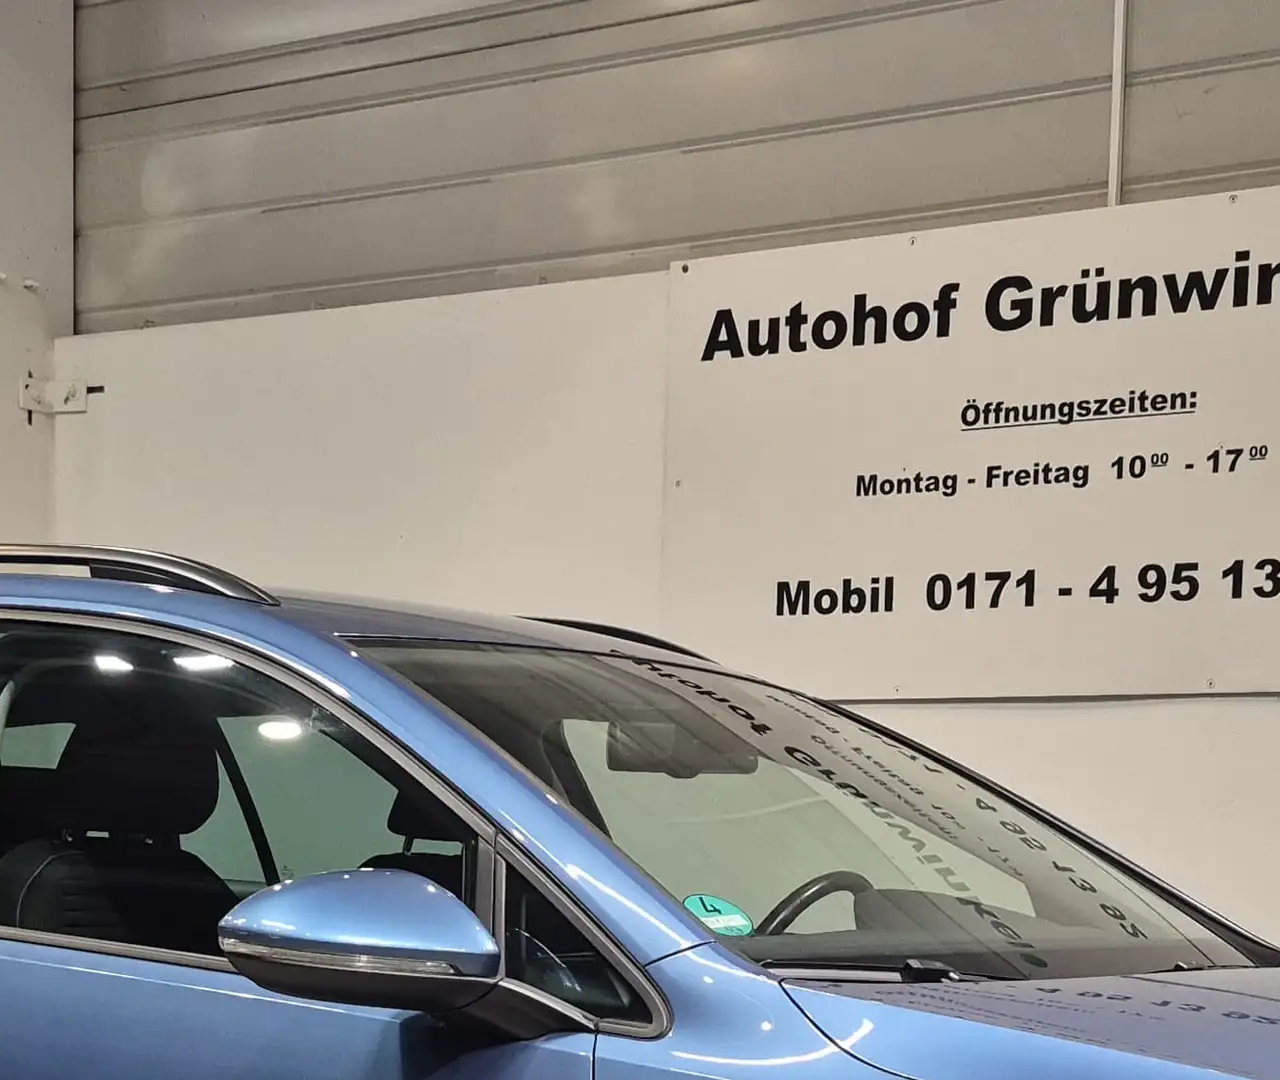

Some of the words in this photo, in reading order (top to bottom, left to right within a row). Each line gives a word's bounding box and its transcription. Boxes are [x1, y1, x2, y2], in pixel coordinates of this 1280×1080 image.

[700, 282, 961, 362] Autohof
[960, 389, 1197, 431] Öffnungszeiten:
[855, 471, 958, 497] Montag
[985, 462, 1090, 490] Freitag
[776, 576, 894, 617] Mobil
[926, 569, 1036, 611] 0171
[1058, 587, 1073, 597] -
[1088, 565, 1120, 604] 4
[1137, 562, 1200, 603] 95
[698, 896, 722, 915] 4
